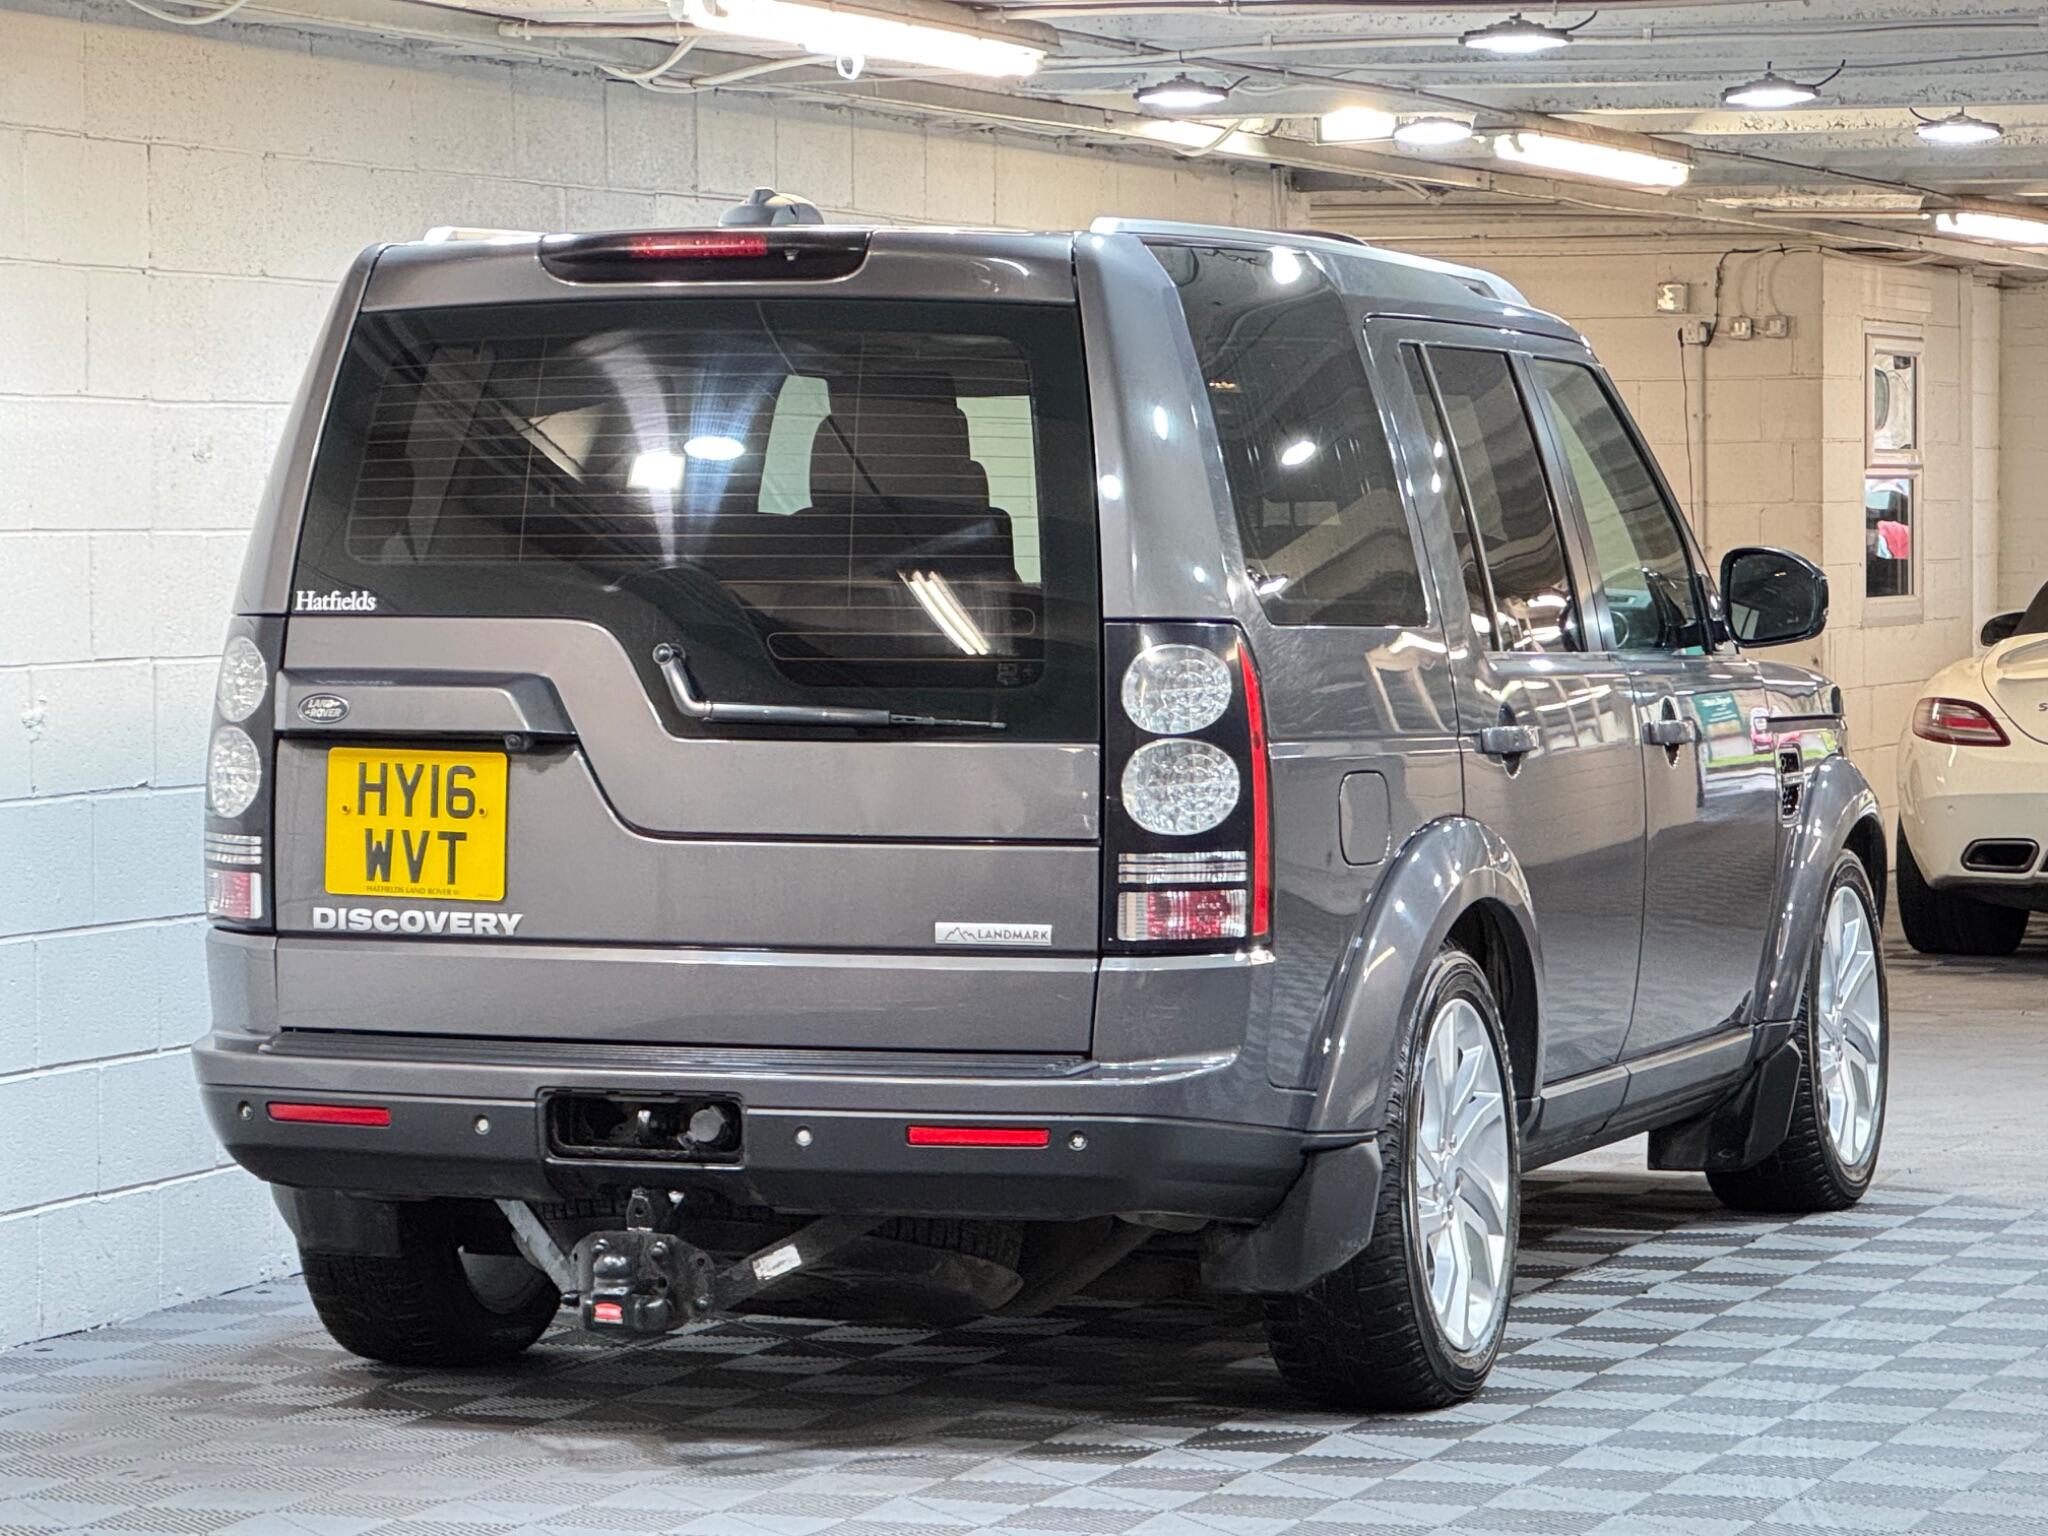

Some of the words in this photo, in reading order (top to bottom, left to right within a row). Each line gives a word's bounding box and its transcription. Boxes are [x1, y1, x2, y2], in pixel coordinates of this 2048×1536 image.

[295, 590, 377, 611] Hatfields
[357, 761, 476, 819] HY16
[364, 828, 467, 885] WVT
[312, 907, 524, 936] DISCOVERY
[977, 928, 1049, 941] LANDMARK
